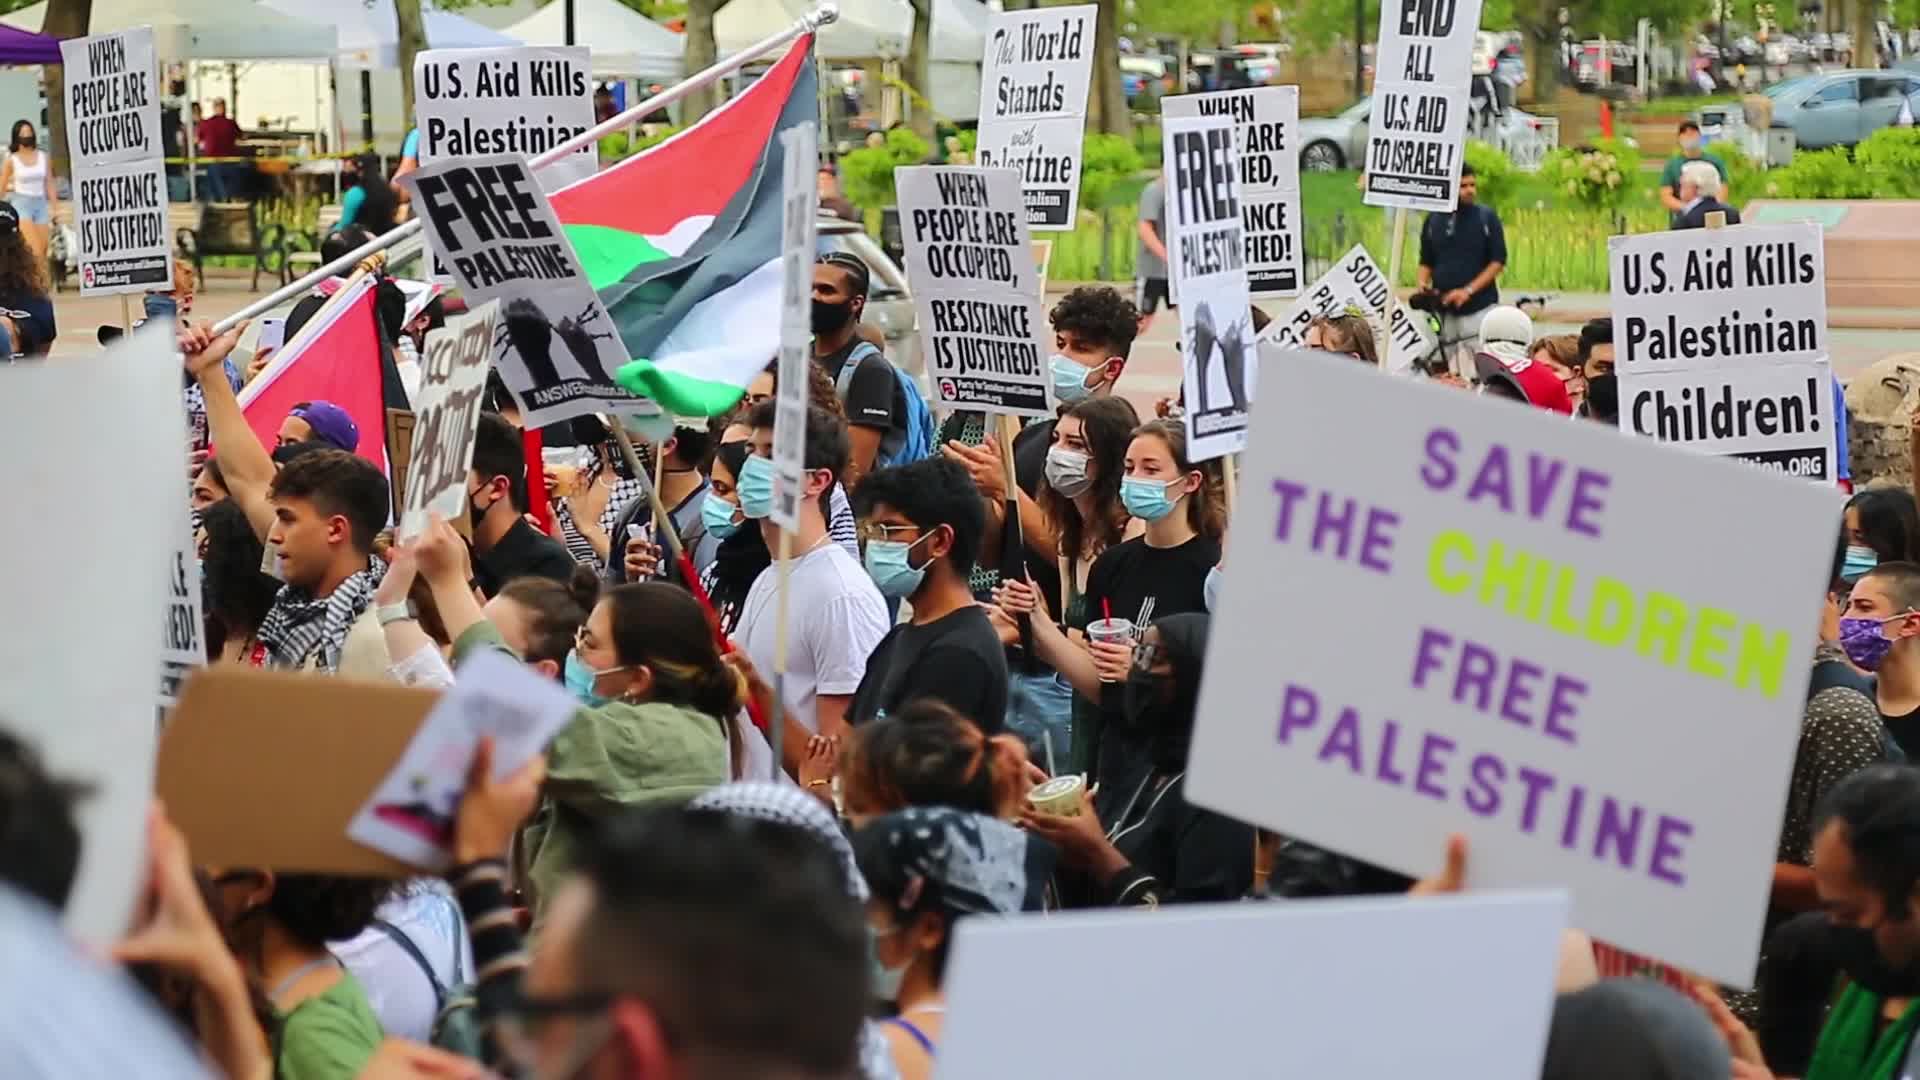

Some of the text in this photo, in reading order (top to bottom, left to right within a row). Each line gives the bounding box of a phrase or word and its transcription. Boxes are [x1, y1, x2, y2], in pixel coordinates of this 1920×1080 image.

[1400, 0, 1456, 37] END
[88, 36, 126, 78] WHEN
[994, 18, 1083, 67] The World
[1404, 44, 1435, 82] ALL
[72, 71, 148, 119] PEOPLE ARE
[424, 60, 585, 99] U.S. Aid Kills
[996, 71, 1064, 116] Stands
[79, 111, 149, 156] OCCUPIED,
[1011, 123, 1037, 146] with
[1384, 93, 1448, 134] U.S. AID
[1174, 128, 1238, 226] FREE
[1372, 137, 1454, 177] TO ISRAEL!
[81, 173, 158, 214] RESISTANCE
[416, 163, 553, 252] FREE
[936, 173, 989, 207] WHEN
[82, 212, 163, 258] IS JUSTIFIED!
[913, 208, 1019, 246] PEOPLE ARE
[454, 243, 576, 289] PALESTINE
[927, 245, 1018, 288] OCCUPIED,
[1623, 242, 1815, 296] U.S. Aid Kills
[931, 300, 1031, 338] RESISTANCE
[1626, 308, 1817, 362] Palestinian
[933, 336, 1040, 377] IS JUSTIFIED!
[1632, 377, 1820, 442] Children!
[1421, 429, 1609, 536] SAVE
[1273, 480, 1789, 697] THE CHILDREN
[1412, 629, 1586, 742] FREE
[1279, 685, 1692, 884] PALESTINE
